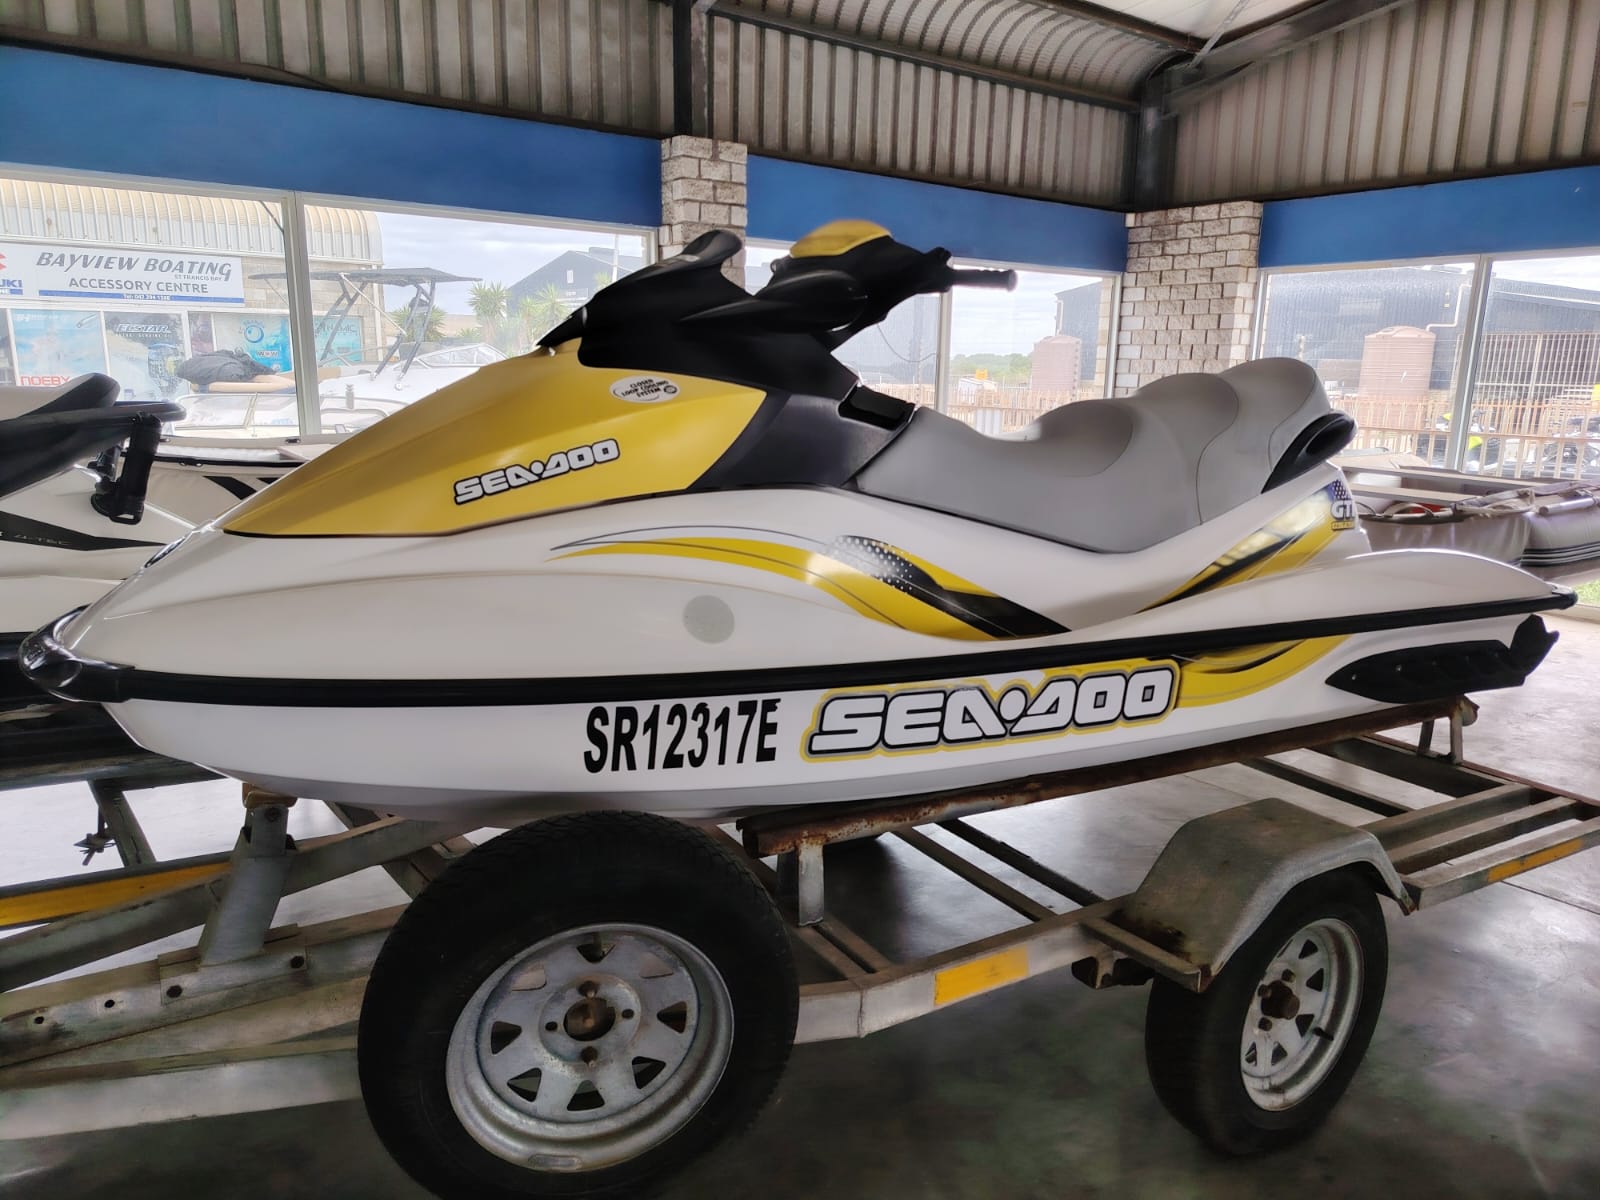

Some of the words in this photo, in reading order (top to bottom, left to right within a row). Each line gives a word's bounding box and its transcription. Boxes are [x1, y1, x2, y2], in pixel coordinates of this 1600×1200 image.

[36, 252, 139, 272] BAYVIEW
[144, 258, 232, 281] BOATING
[69, 278, 152, 290] ACCESSORY
[156, 281, 208, 293] CENTRE
[584, 698, 781, 773] SR12317E
